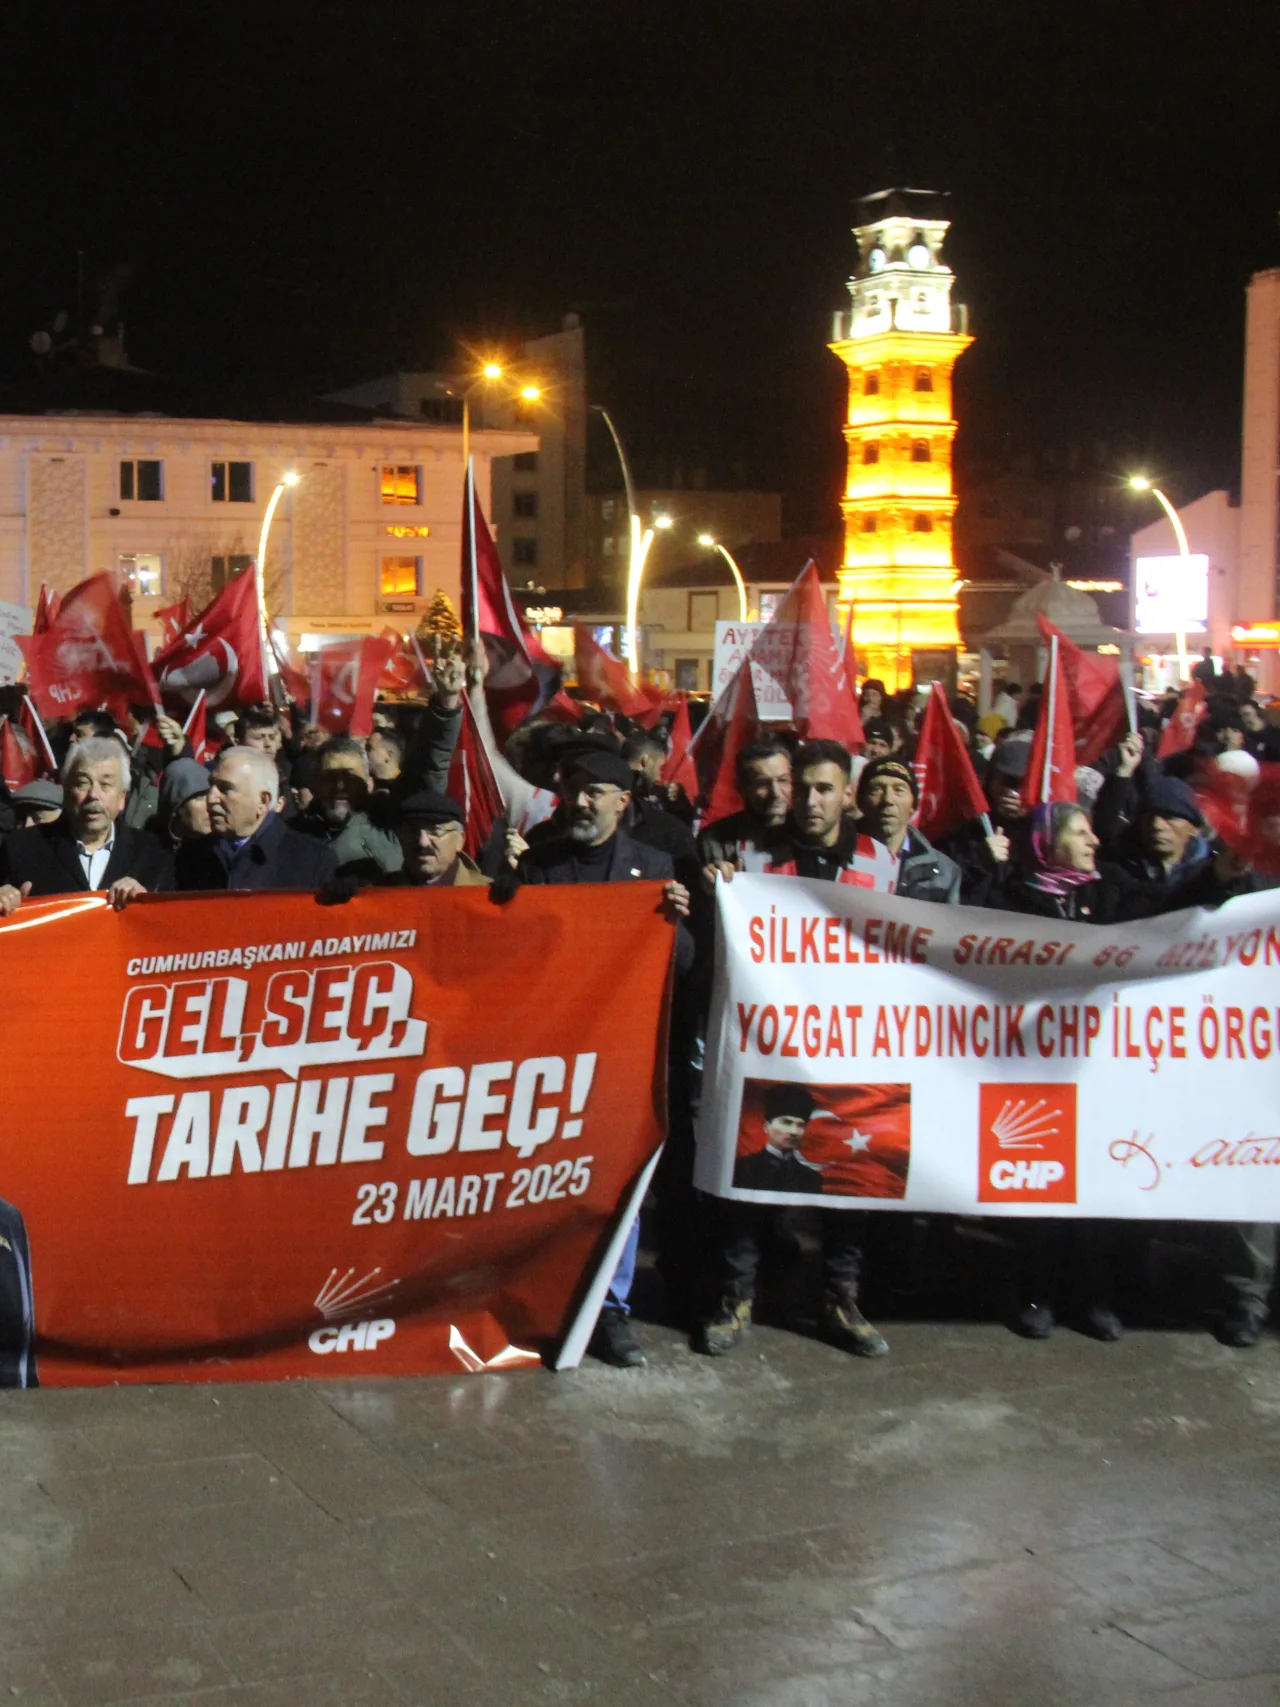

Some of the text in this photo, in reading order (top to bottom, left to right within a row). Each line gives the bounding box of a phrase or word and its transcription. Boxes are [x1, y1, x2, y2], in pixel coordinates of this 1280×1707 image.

[127, 929, 417, 976] CUMHURBAŞKANI ADAYIMIZI
[749, 905, 933, 964] SİLKELEME
[954, 934, 1076, 966] SIRASI
[736, 992, 1280, 1072] YOZGAT AYDINCIK CHP İLÇE ÖRG
[406, 1052, 598, 1158] GEÇ!
[352, 1156, 594, 1225] 23 MART 2025
[989, 1160, 1065, 1190] CHP
[308, 1318, 396, 1355] CHP
